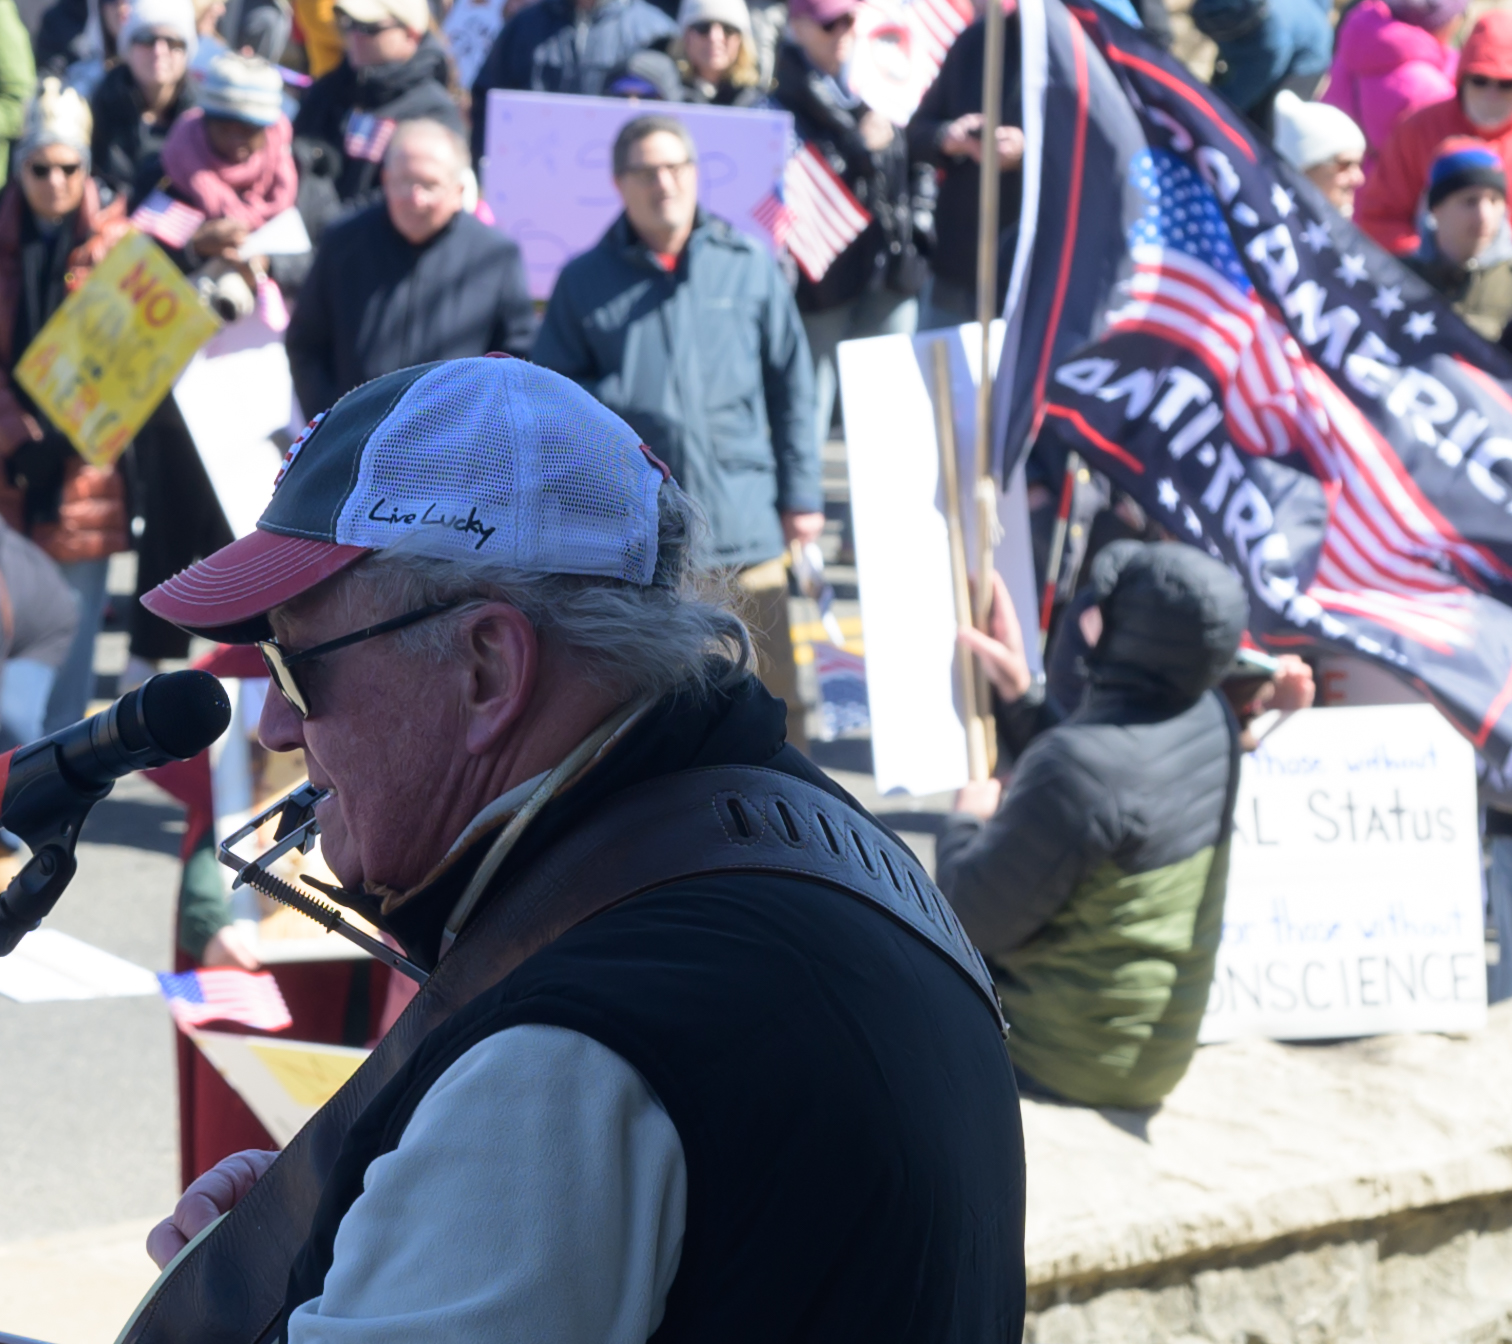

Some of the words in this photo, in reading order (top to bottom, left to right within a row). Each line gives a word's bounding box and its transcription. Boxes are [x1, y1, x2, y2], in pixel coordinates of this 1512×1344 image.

[117, 259, 180, 330] NO
[368, 498, 416, 525] Live
[420, 503, 496, 550] Lucky
[1207, 952, 1478, 1017] ONSCIENCE
